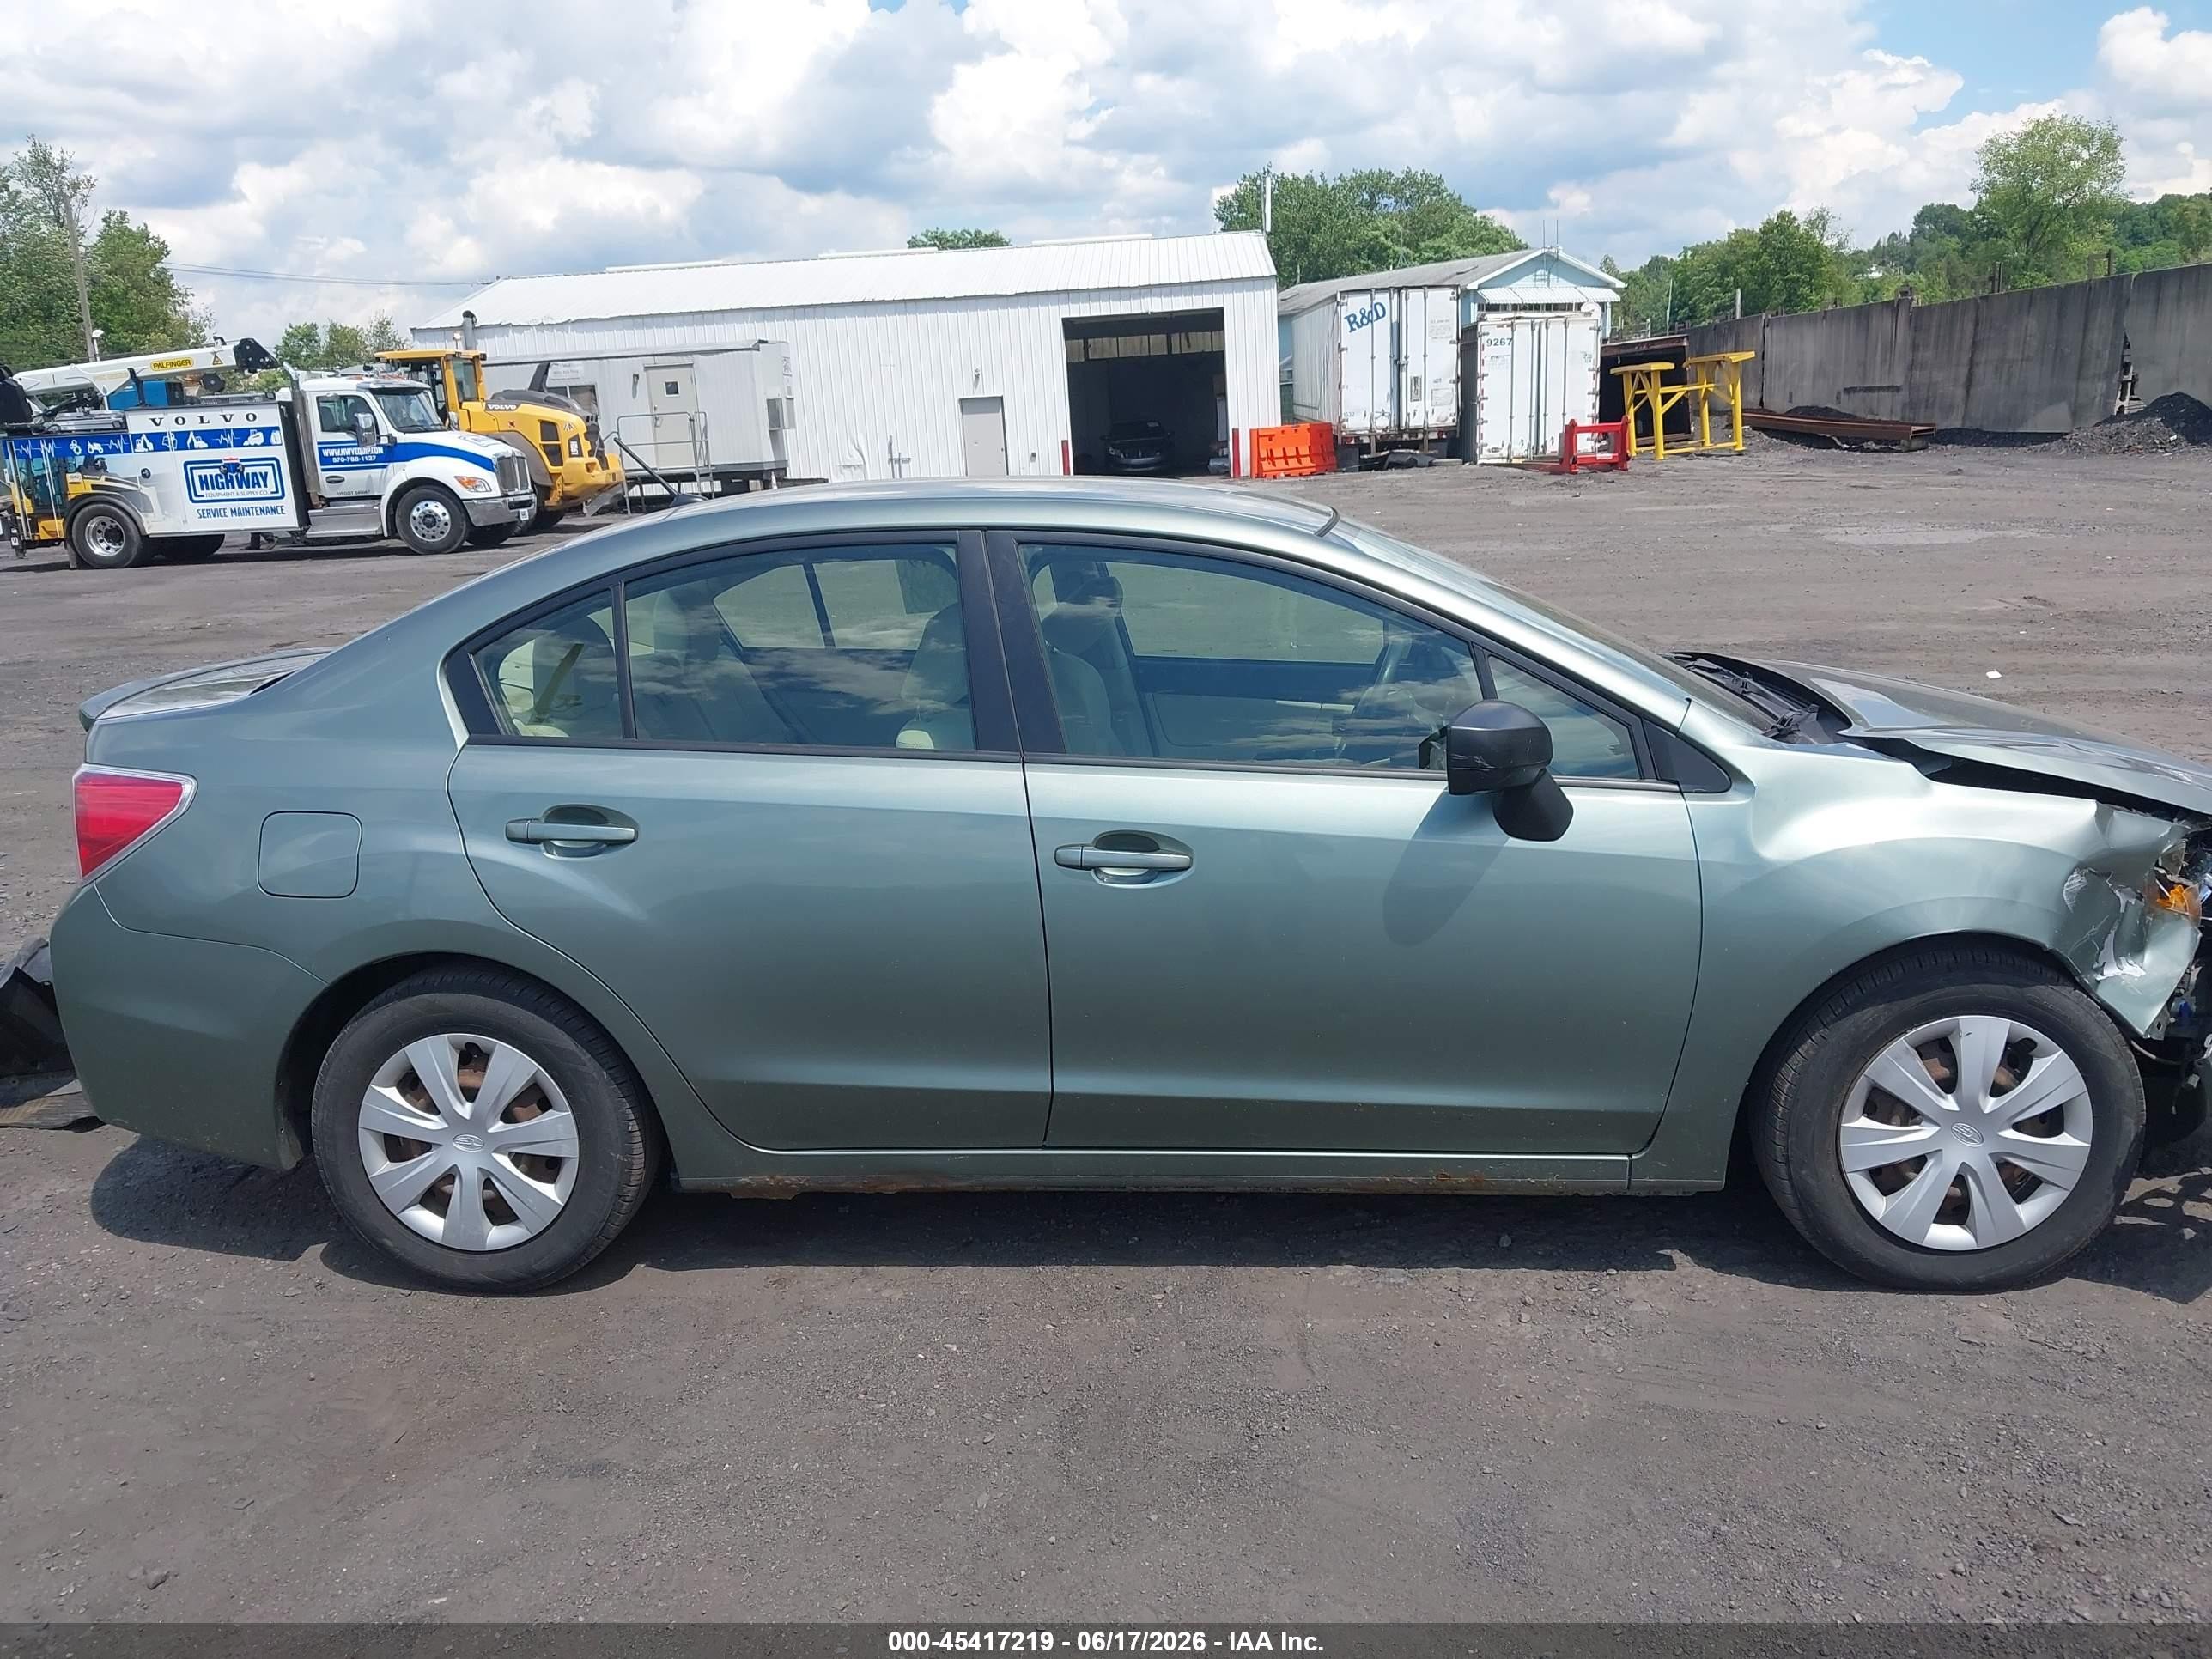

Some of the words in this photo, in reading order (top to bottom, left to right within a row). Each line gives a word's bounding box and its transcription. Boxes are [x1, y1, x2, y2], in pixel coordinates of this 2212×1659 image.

[1344, 302, 1387, 333] R&D
[1486, 337, 1513, 347] 9267
[153, 358, 191, 370] PALFINGER
[149, 412, 257, 427] VOLVO
[198, 471, 269, 491] HIGHWAY
[197, 507, 228, 519] SERVICE
[230, 505, 286, 517] MAINTENANCE
